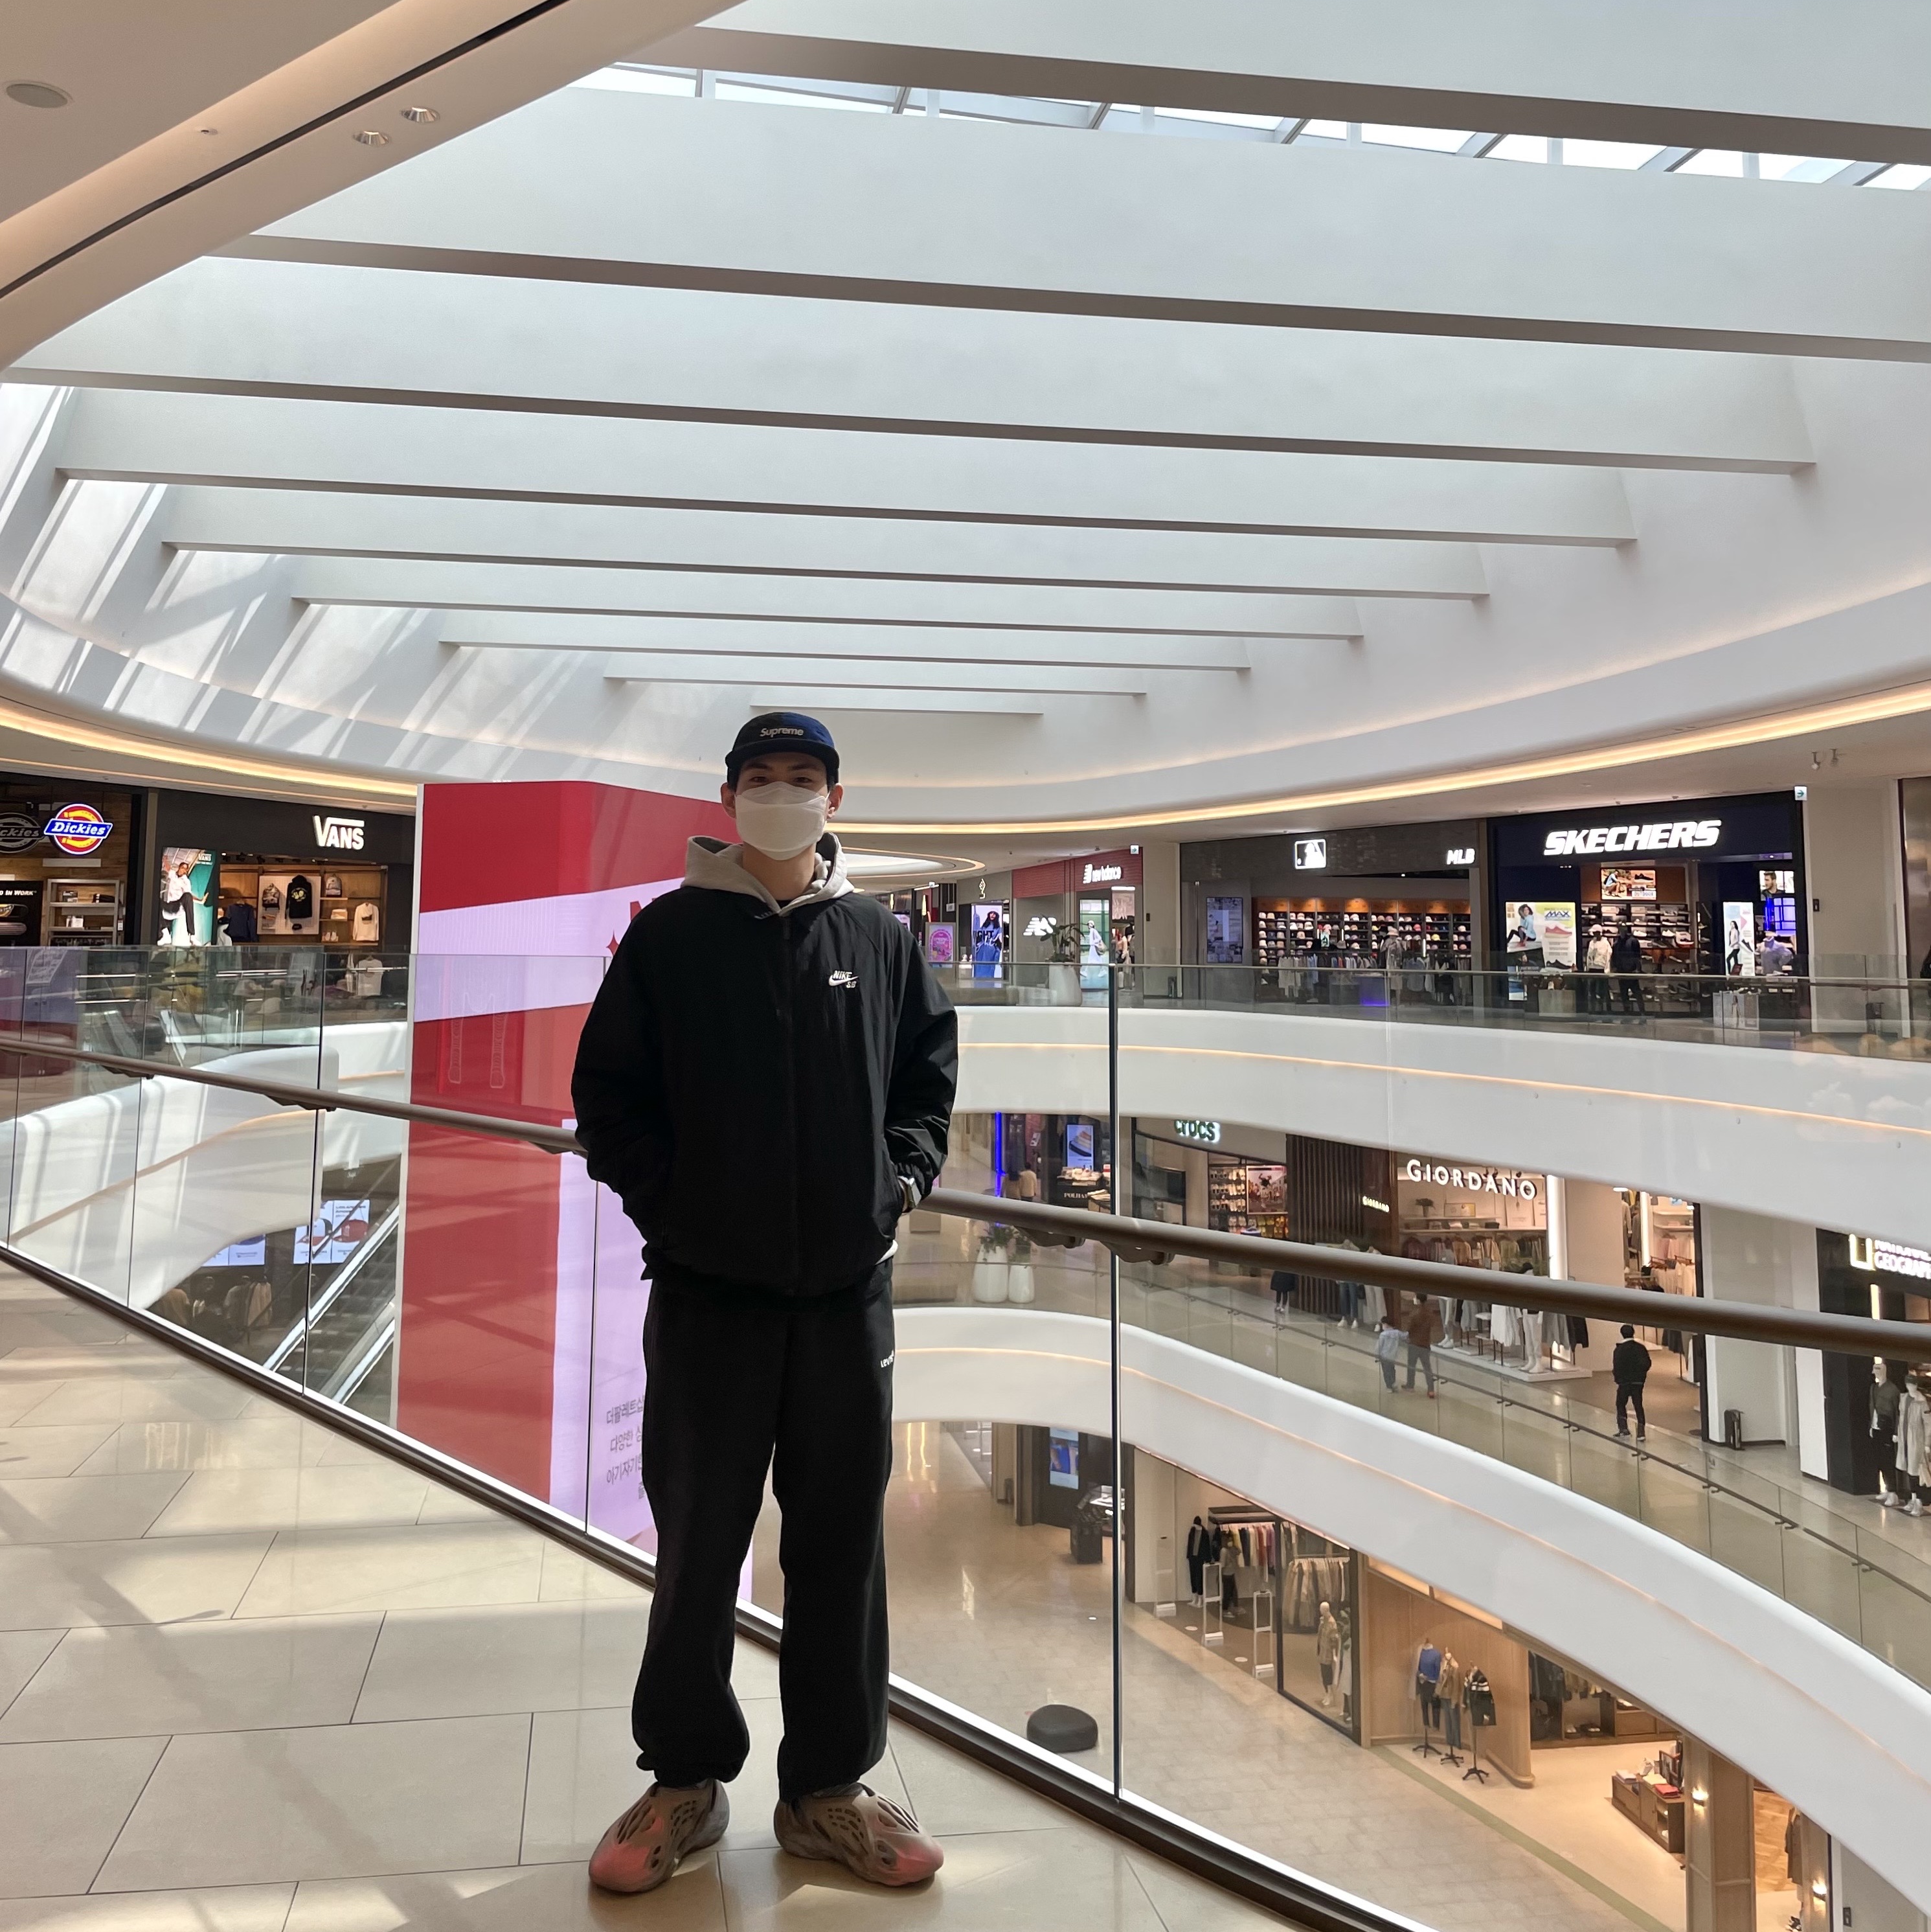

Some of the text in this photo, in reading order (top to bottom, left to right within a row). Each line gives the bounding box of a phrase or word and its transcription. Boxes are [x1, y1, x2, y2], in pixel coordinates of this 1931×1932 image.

[760, 728, 804, 738] Supreme
[0, 828, 40, 837] ckies
[51, 822, 106, 835] Dickies
[312, 815, 365, 850] VANS
[1544, 820, 1722, 856] SKECHERS
[1447, 848, 1475, 865] MLB
[833, 970, 853, 980] NIKE
[1174, 1119, 1218, 1142] crocs
[1406, 1159, 1537, 1200] GIORDANO
